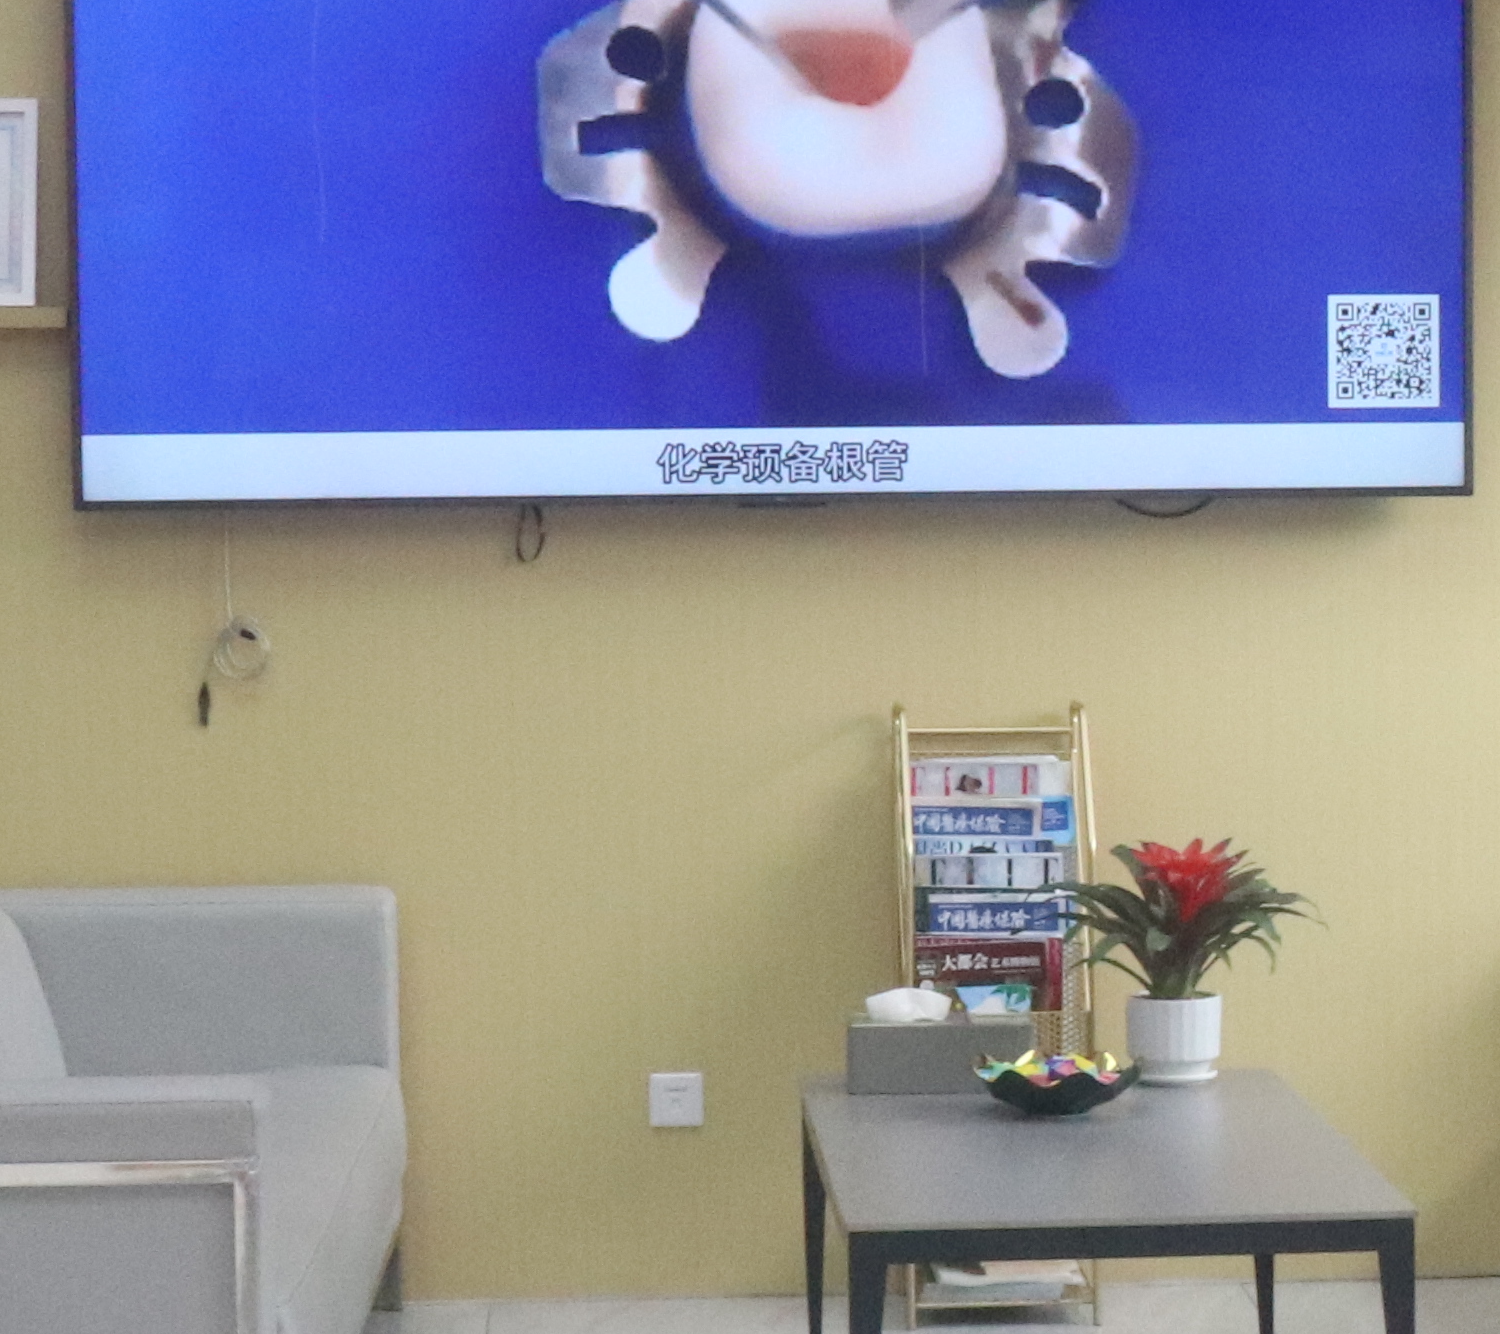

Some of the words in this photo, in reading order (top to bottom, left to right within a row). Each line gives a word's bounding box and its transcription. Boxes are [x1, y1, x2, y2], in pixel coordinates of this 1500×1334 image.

[656, 439, 908, 484] 化学预备根管
